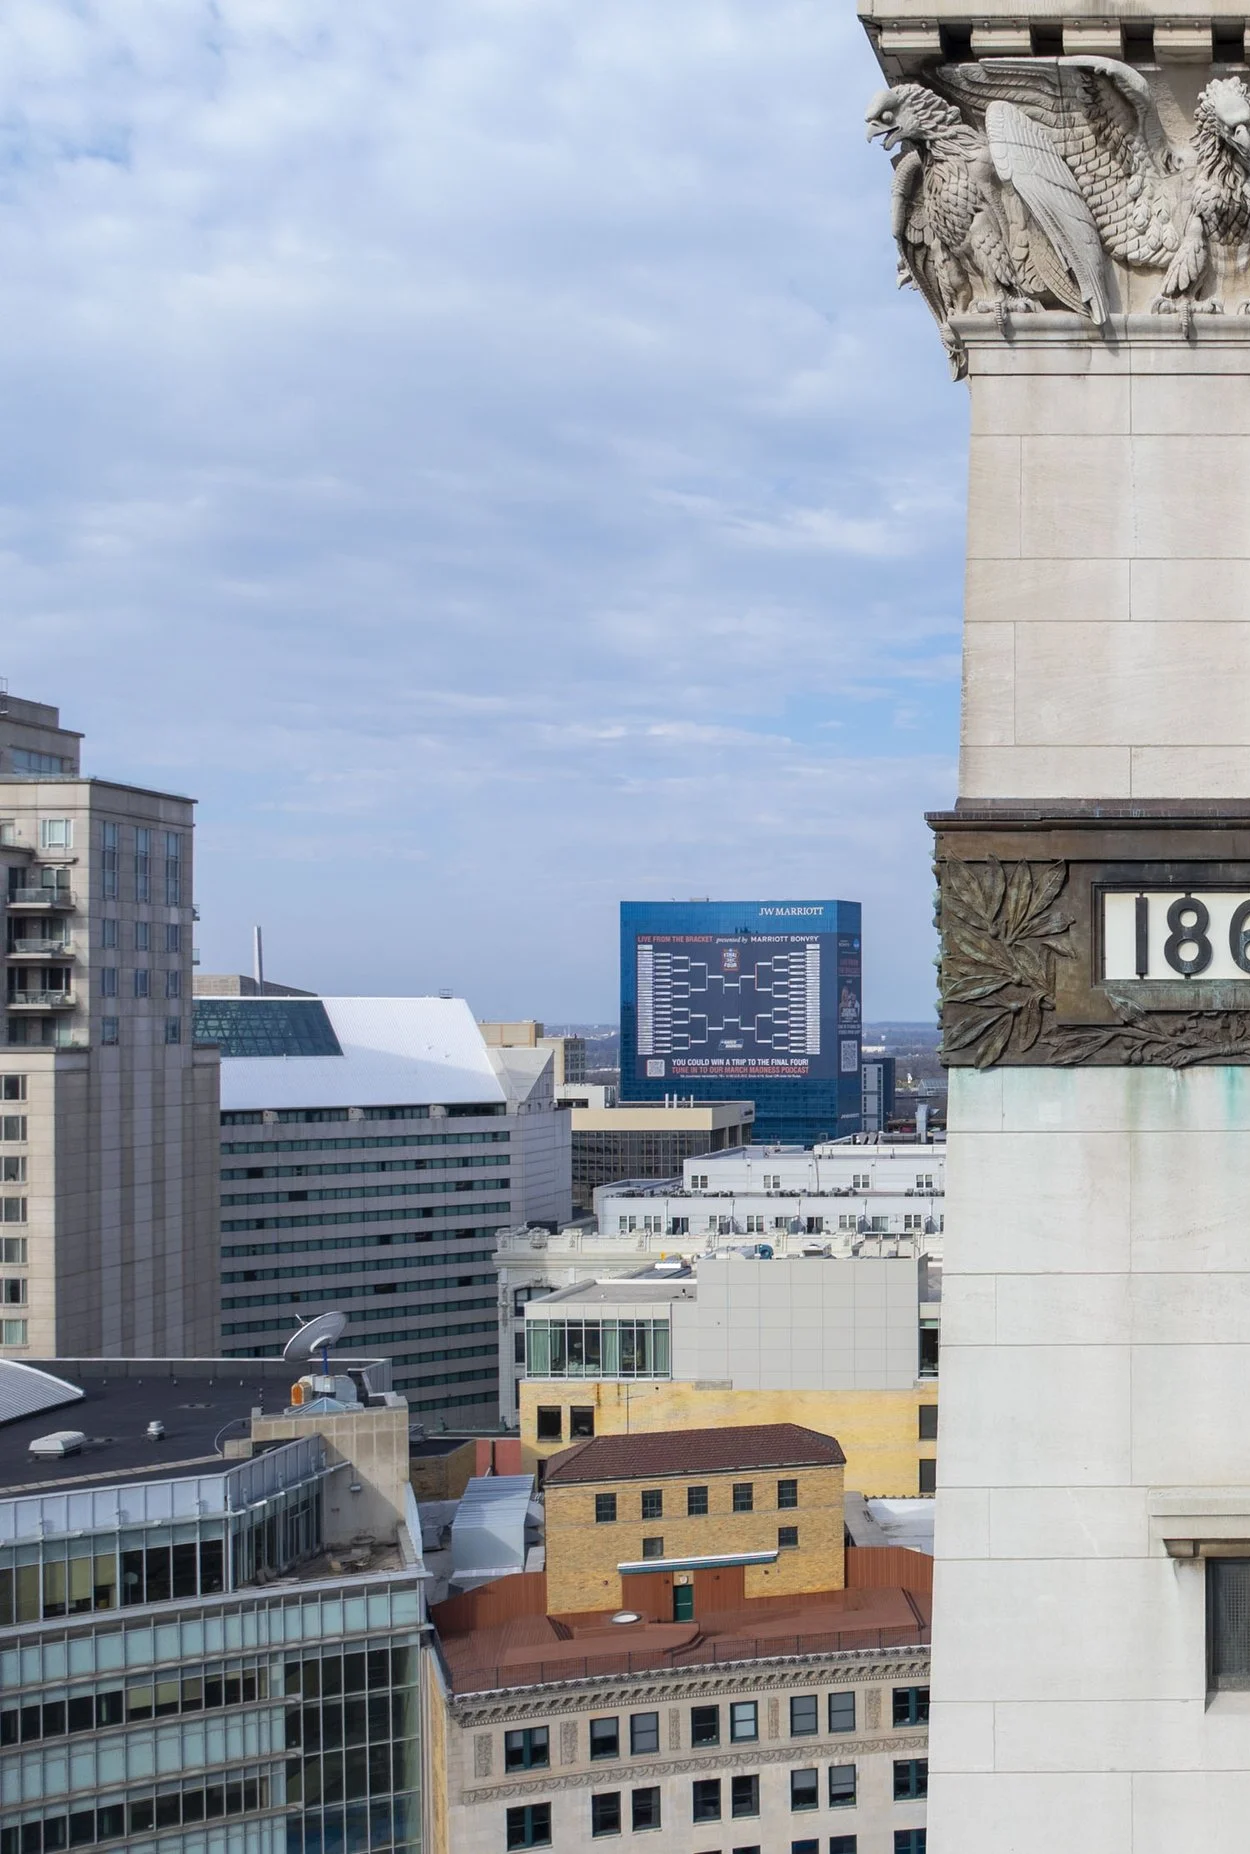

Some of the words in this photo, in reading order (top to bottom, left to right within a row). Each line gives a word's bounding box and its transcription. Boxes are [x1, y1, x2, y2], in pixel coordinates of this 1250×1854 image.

[759, 908, 775, 916] JW
[776, 906, 824, 915] MARRIOTT
[715, 936, 741, 944] presented
